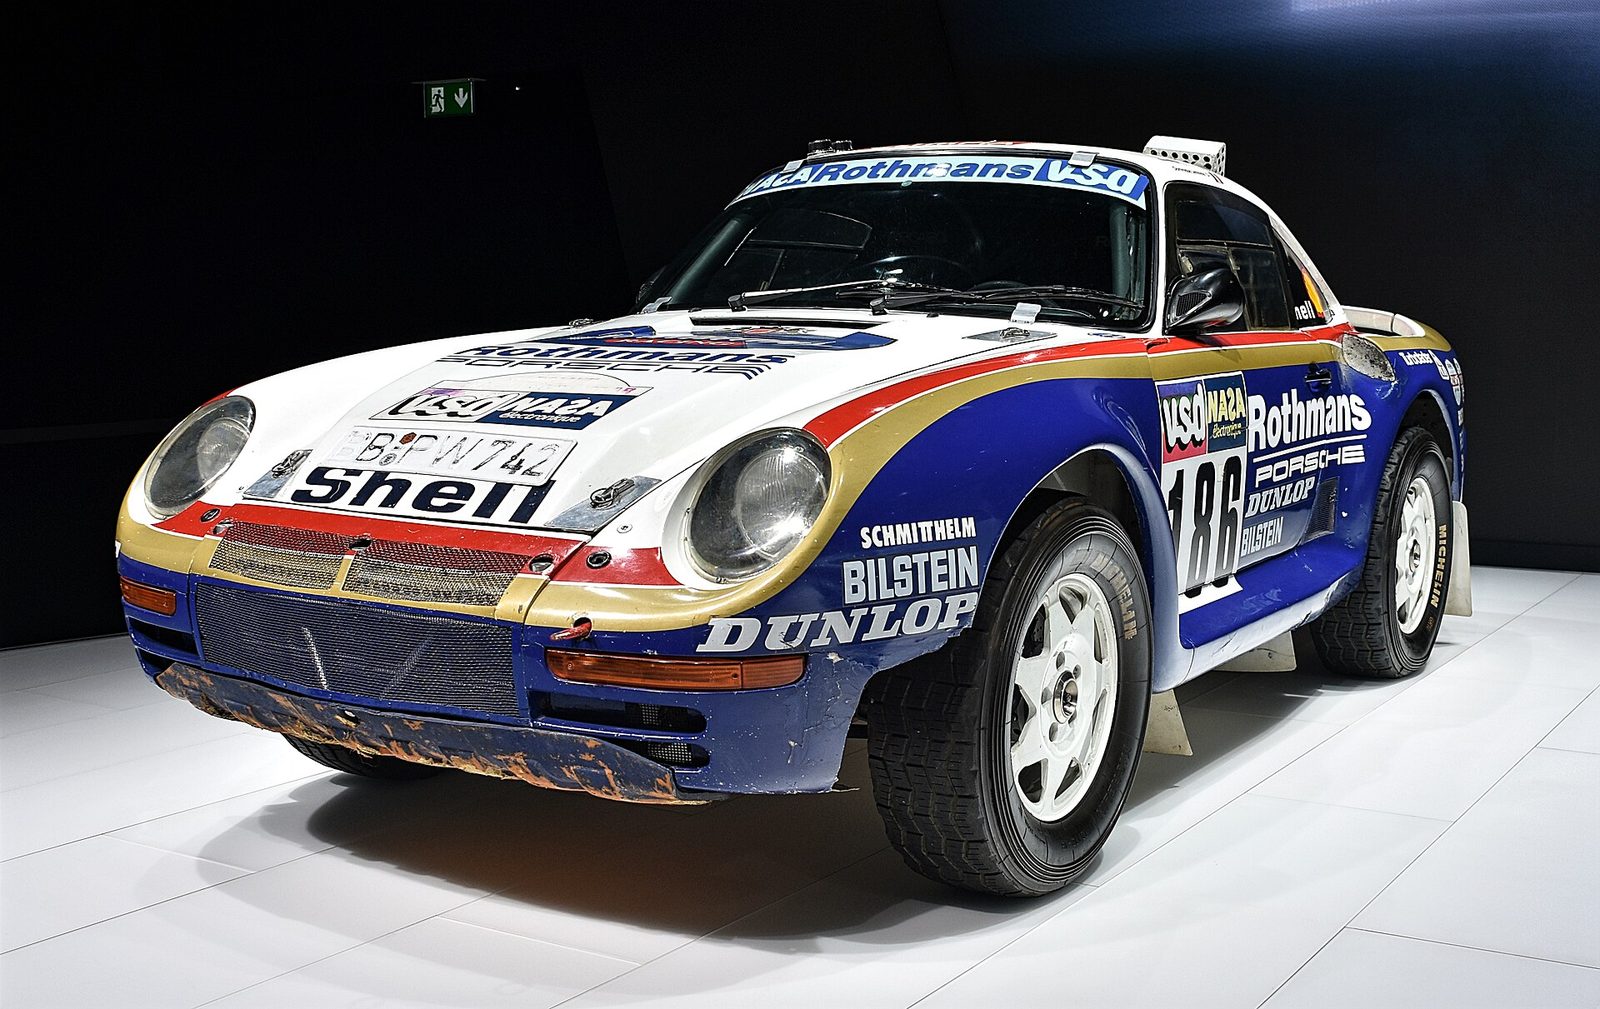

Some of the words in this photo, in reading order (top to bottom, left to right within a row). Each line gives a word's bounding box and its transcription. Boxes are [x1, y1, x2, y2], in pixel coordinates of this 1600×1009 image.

[811, 159, 1036, 185] Rothmans
[435, 357, 772, 381] PORSCHE
[453, 345, 796, 364] Rothmans
[1247, 388, 1373, 453] Rothmans
[1255, 445, 1365, 488] PORSCHE
[290, 466, 557, 524] Shell
[1245, 477, 1316, 519] DUNLOP
[1167, 455, 1243, 599] 186
[1240, 516, 1284, 558] BILSTEIN
[843, 546, 979, 604] BILSTEIN
[1430, 524, 1447, 609] MICHELIN
[696, 592, 980, 653] DUNLOP
